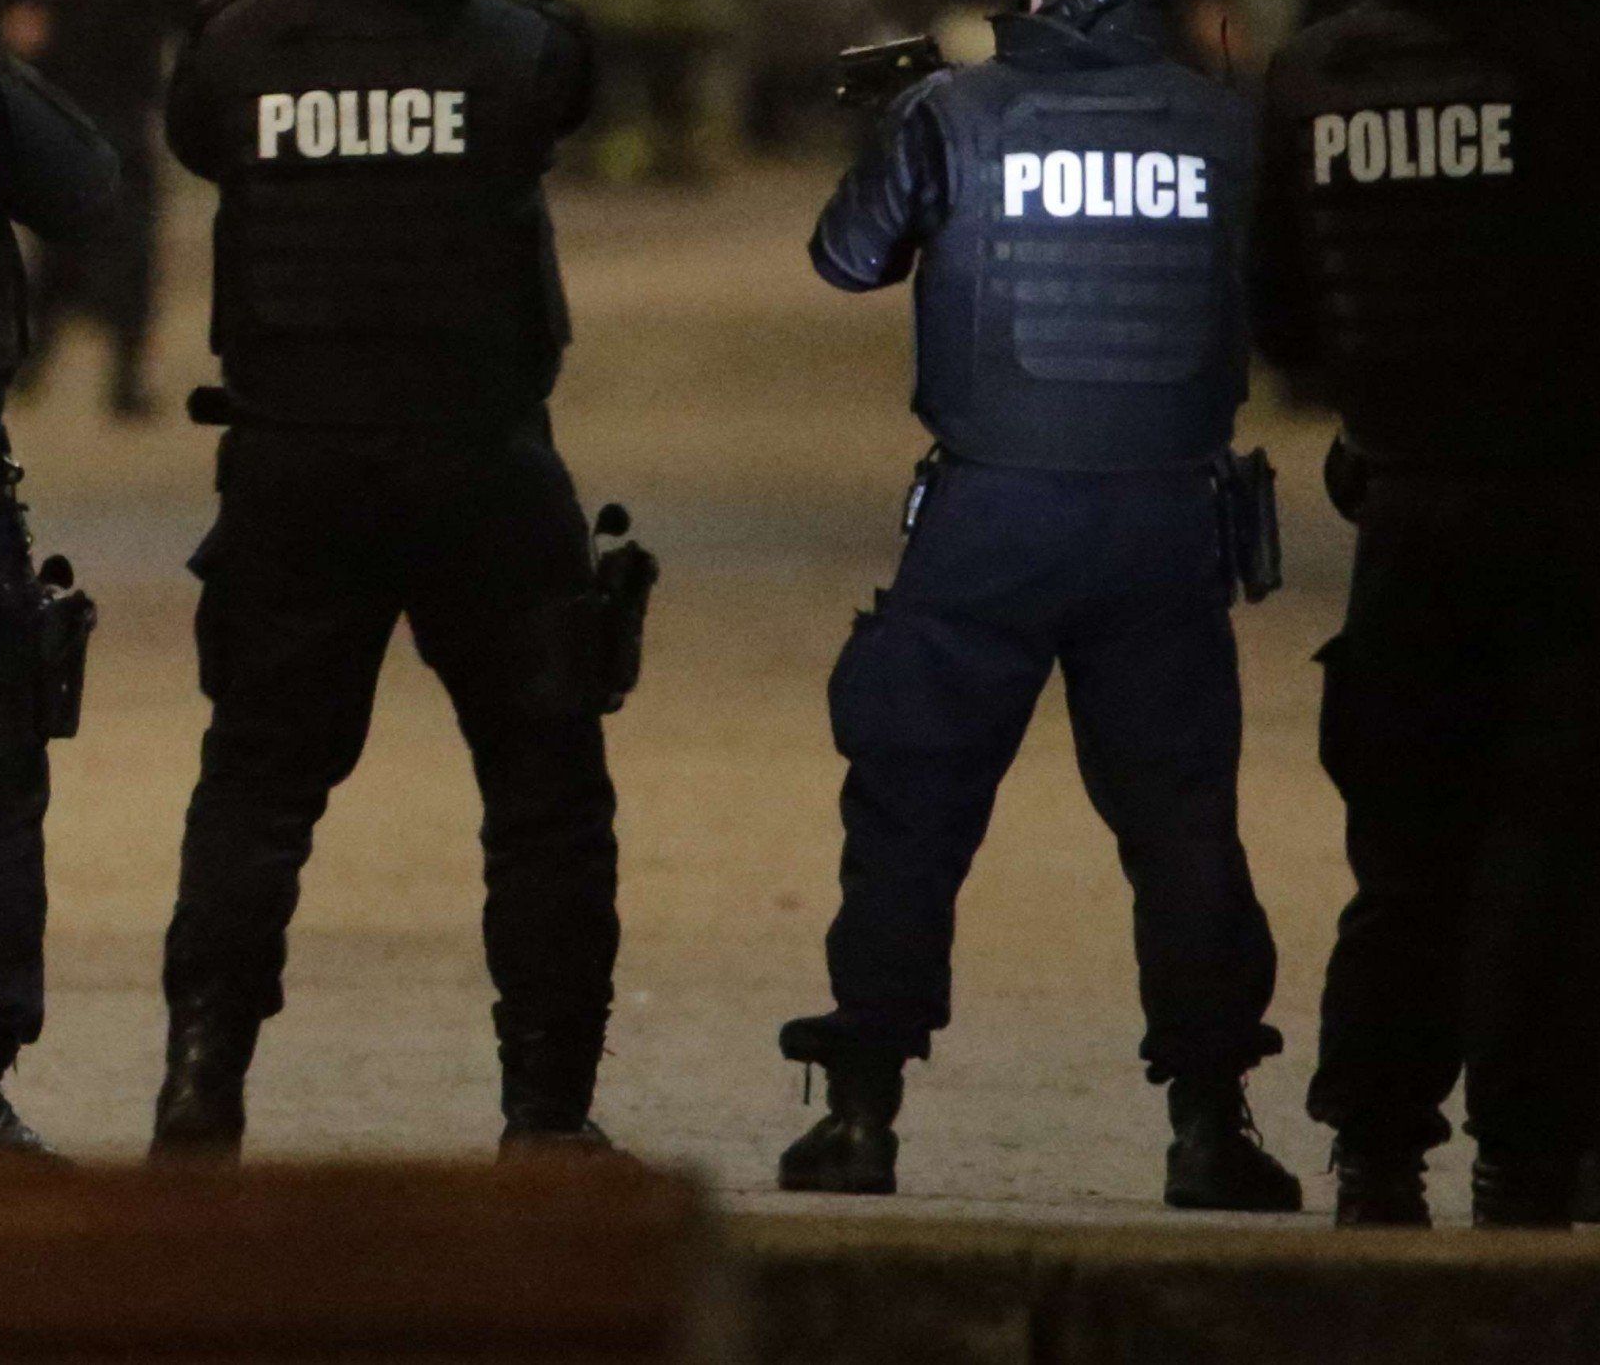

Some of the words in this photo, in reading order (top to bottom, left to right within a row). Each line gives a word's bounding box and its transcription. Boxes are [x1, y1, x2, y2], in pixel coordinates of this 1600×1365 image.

[258, 88, 465, 158] POLICE
[1314, 103, 1513, 184] POLICE
[1004, 149, 1208, 218] POLICE
